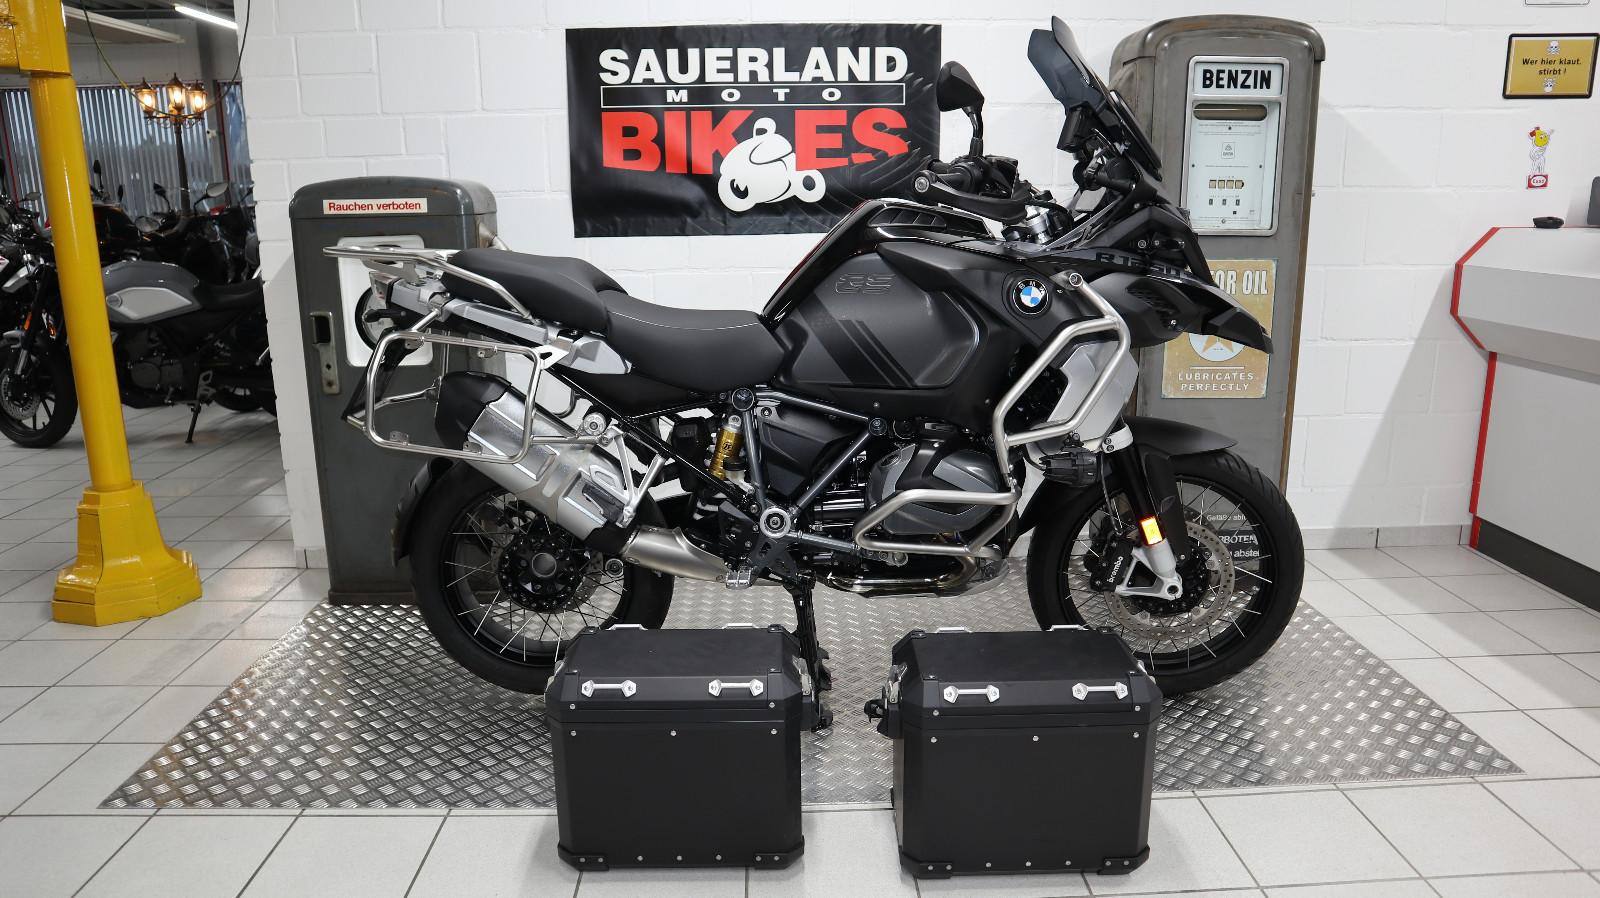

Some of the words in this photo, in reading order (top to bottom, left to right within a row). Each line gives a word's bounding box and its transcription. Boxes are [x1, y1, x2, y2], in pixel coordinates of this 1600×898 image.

[598, 46, 908, 84] SAUERLAND
[1522, 57, 1538, 65] Wer
[1540, 57, 1557, 65] hier
[1202, 68, 1272, 90] BENZIN
[666, 87, 842, 103] MOTO
[328, 202, 374, 212] Rauchen
[376, 201, 421, 211] verboten
[1018, 280, 1046, 297] BMW
[1242, 269, 1268, 295] OIL
[1178, 372, 1254, 381] LUBRICATES
[1180, 383, 1250, 391] PERFECTLY
[1218, 534, 1258, 544] RBOTEN
[1106, 555, 1124, 583] brembo
